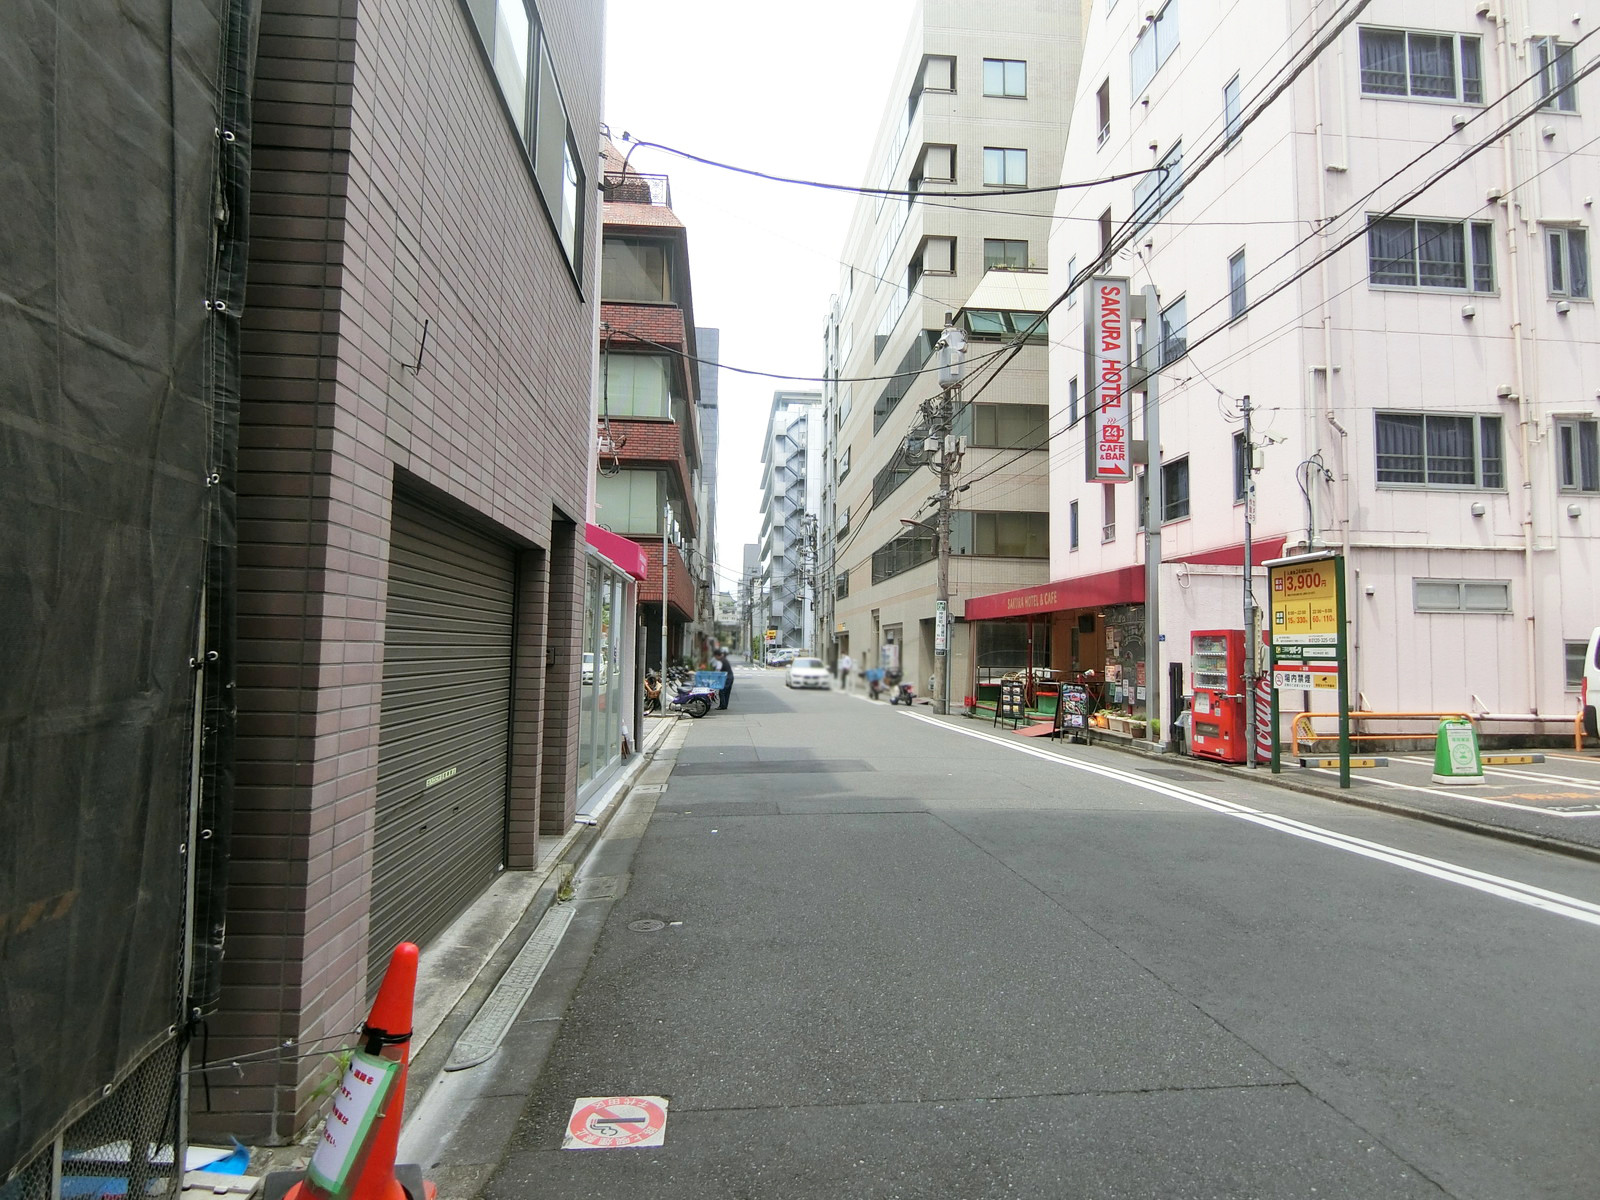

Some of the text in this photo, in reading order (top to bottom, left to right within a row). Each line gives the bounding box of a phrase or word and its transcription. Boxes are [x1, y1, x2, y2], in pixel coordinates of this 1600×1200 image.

[1101, 286, 1122, 414] SAKURA HOTEL
[1105, 427, 1118, 436] 24
[1025, 594, 1039, 608] HOTEL
[1040, 593, 1044, 606] &
[1045, 591, 1057, 605] CAFE
